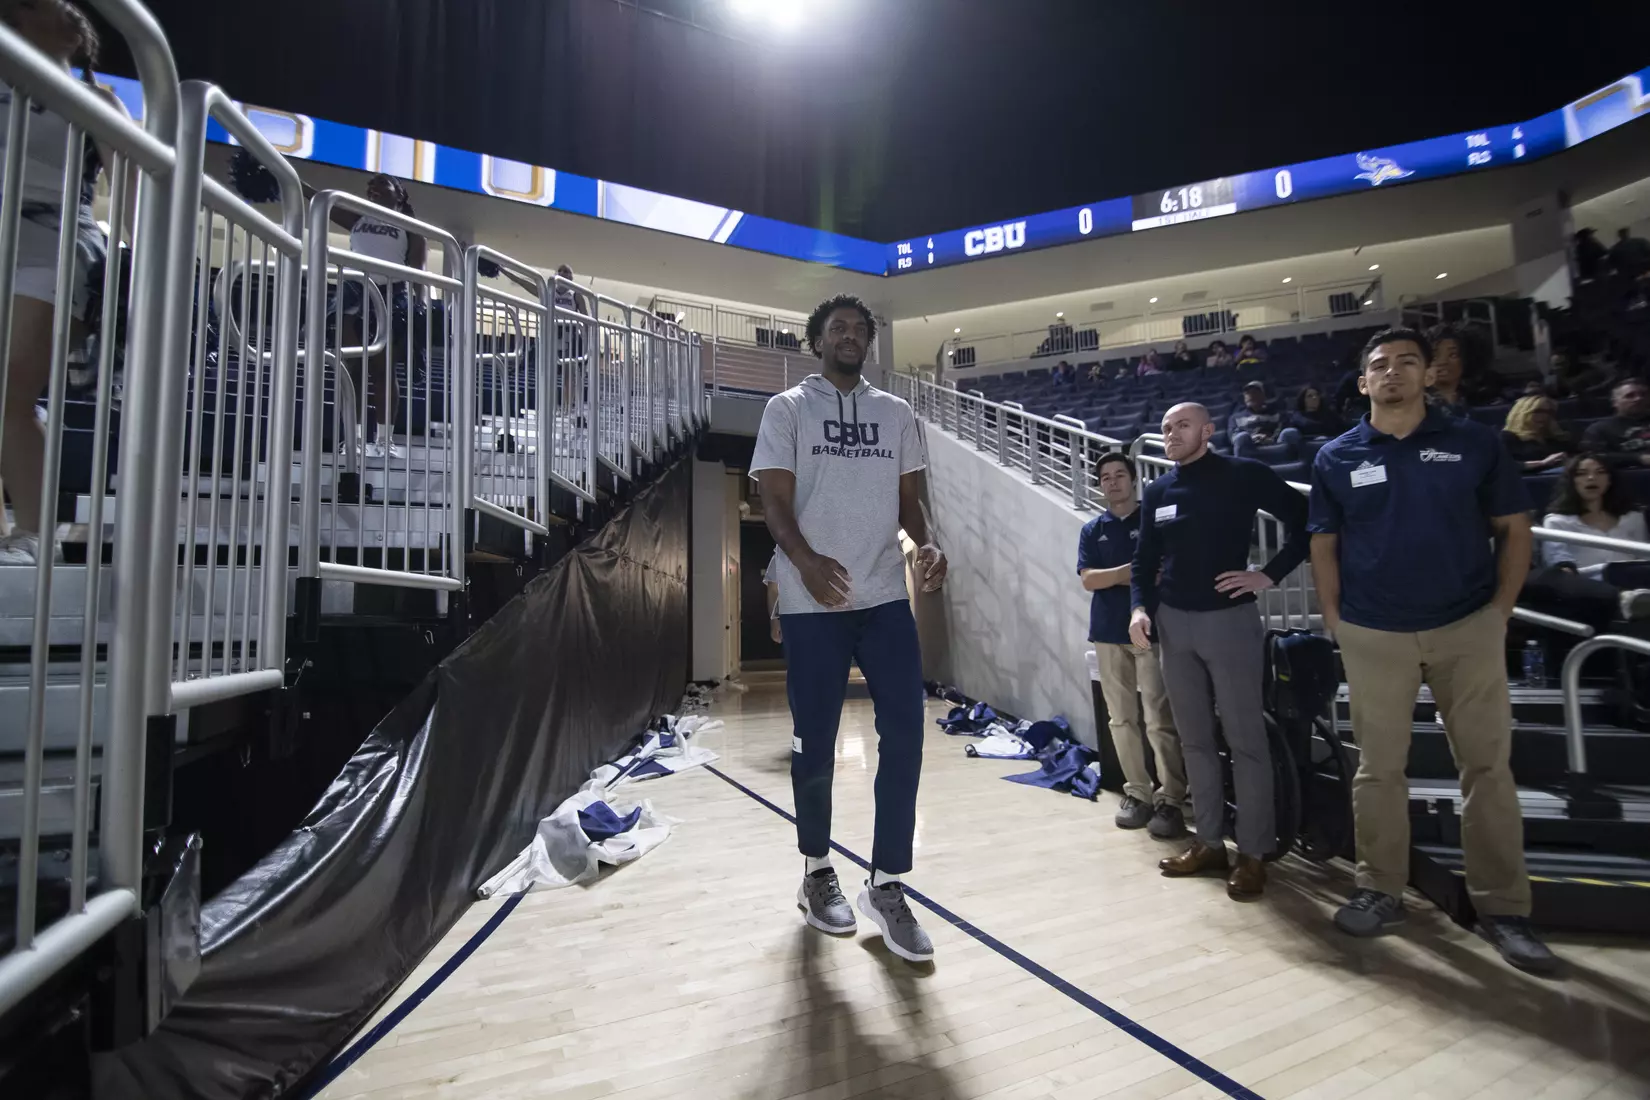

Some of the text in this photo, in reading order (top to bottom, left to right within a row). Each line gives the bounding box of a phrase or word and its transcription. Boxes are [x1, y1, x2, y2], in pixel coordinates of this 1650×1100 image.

[1275, 170, 1292, 198] 0
[1160, 186, 1203, 213] 6:18
[1078, 208, 1093, 235] 0
[964, 221, 1027, 257] CBU
[823, 420, 879, 446] CBU
[812, 445, 894, 459] BASKETBALL
